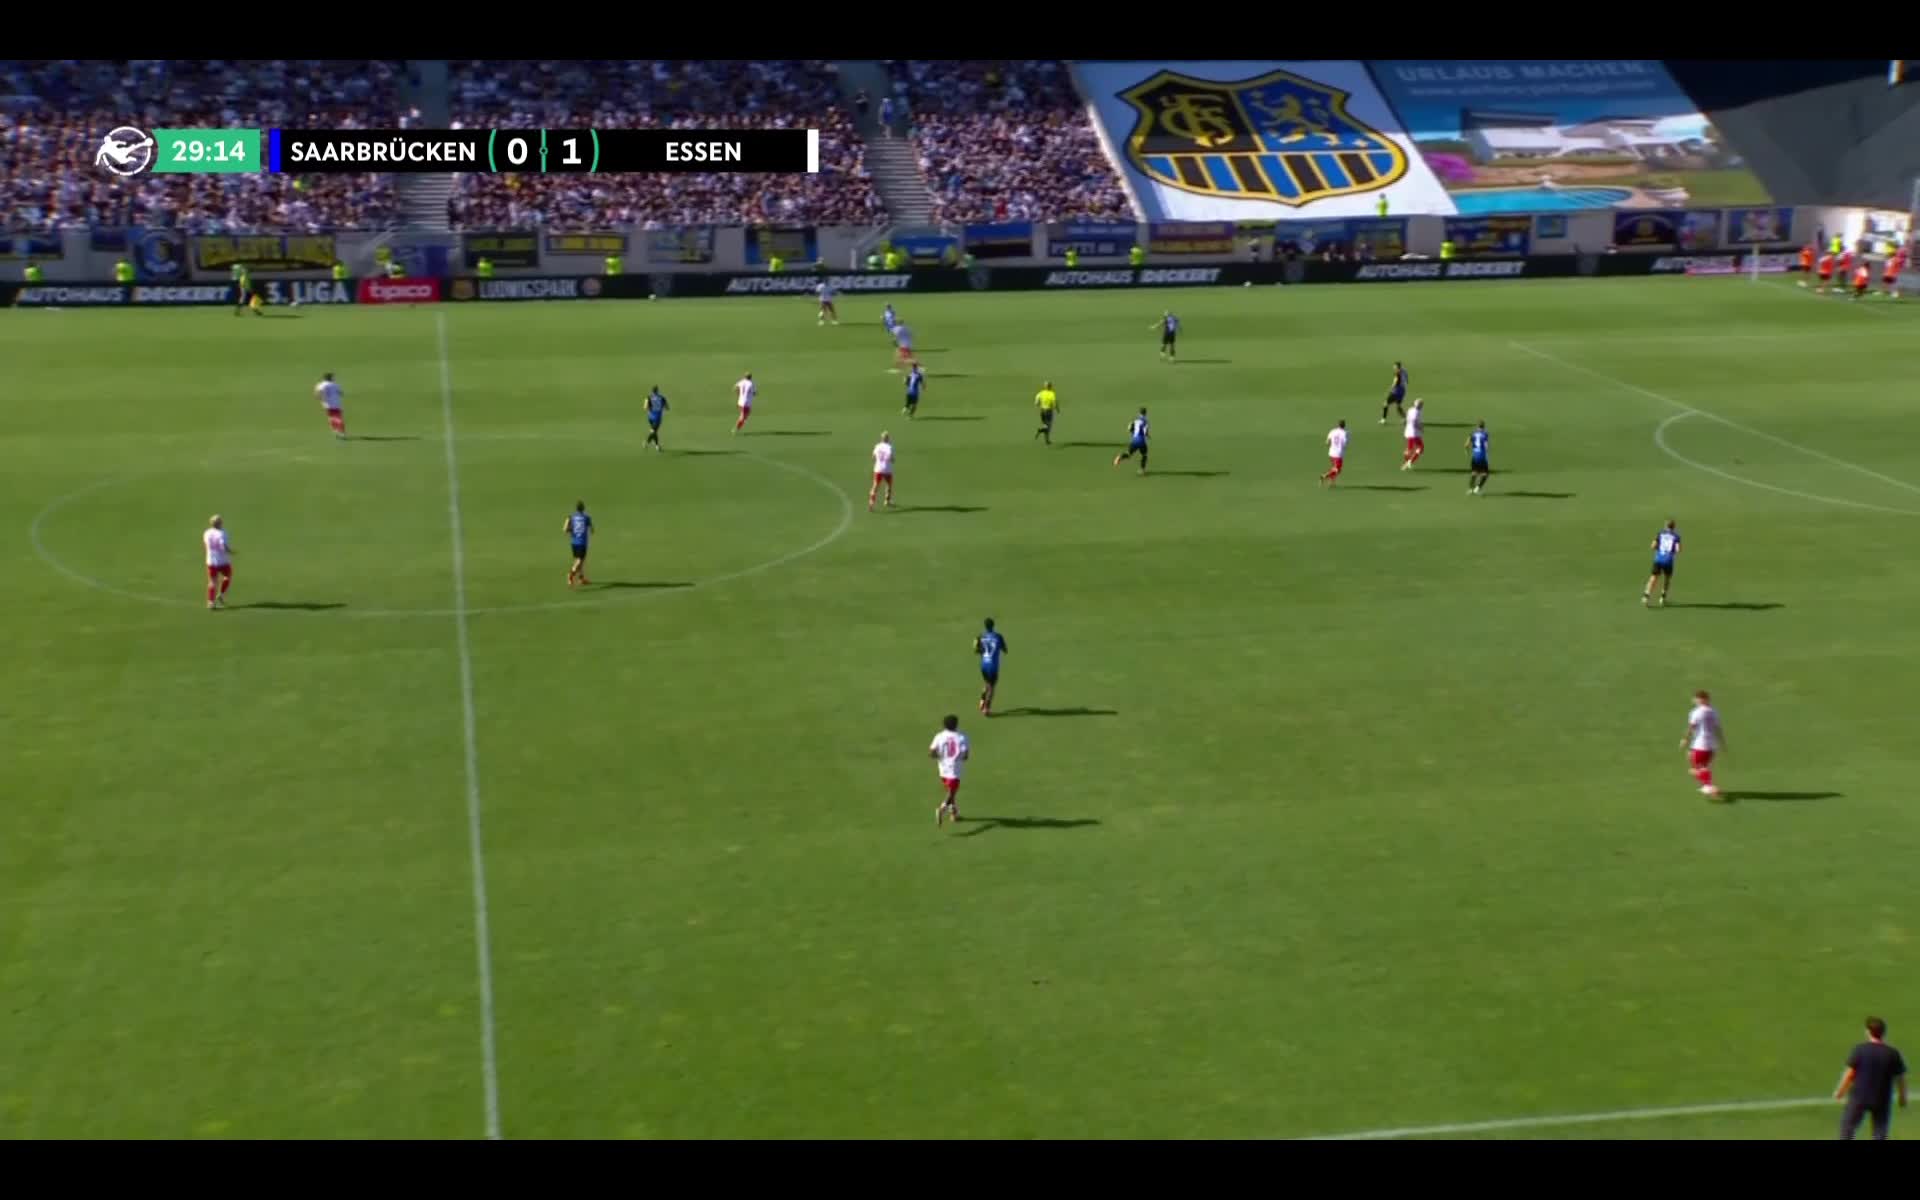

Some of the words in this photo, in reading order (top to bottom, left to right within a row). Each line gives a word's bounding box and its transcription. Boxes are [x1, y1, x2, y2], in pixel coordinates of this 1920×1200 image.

[1396, 64, 1514, 81] URLAUB
[727, 275, 818, 293] AUTOHAUS
[825, 273, 912, 291] DECKERT
[1045, 270, 1133, 286] AUTOHAUS
[1140, 267, 1222, 283] DECKERT
[18, 286, 123, 301] AUTOHAUS
[132, 285, 230, 301] DECKERT
[266, 282, 287, 303] 3.
[291, 281, 349, 303] LIGA
[479, 279, 578, 298] LUDWIGSPARK
